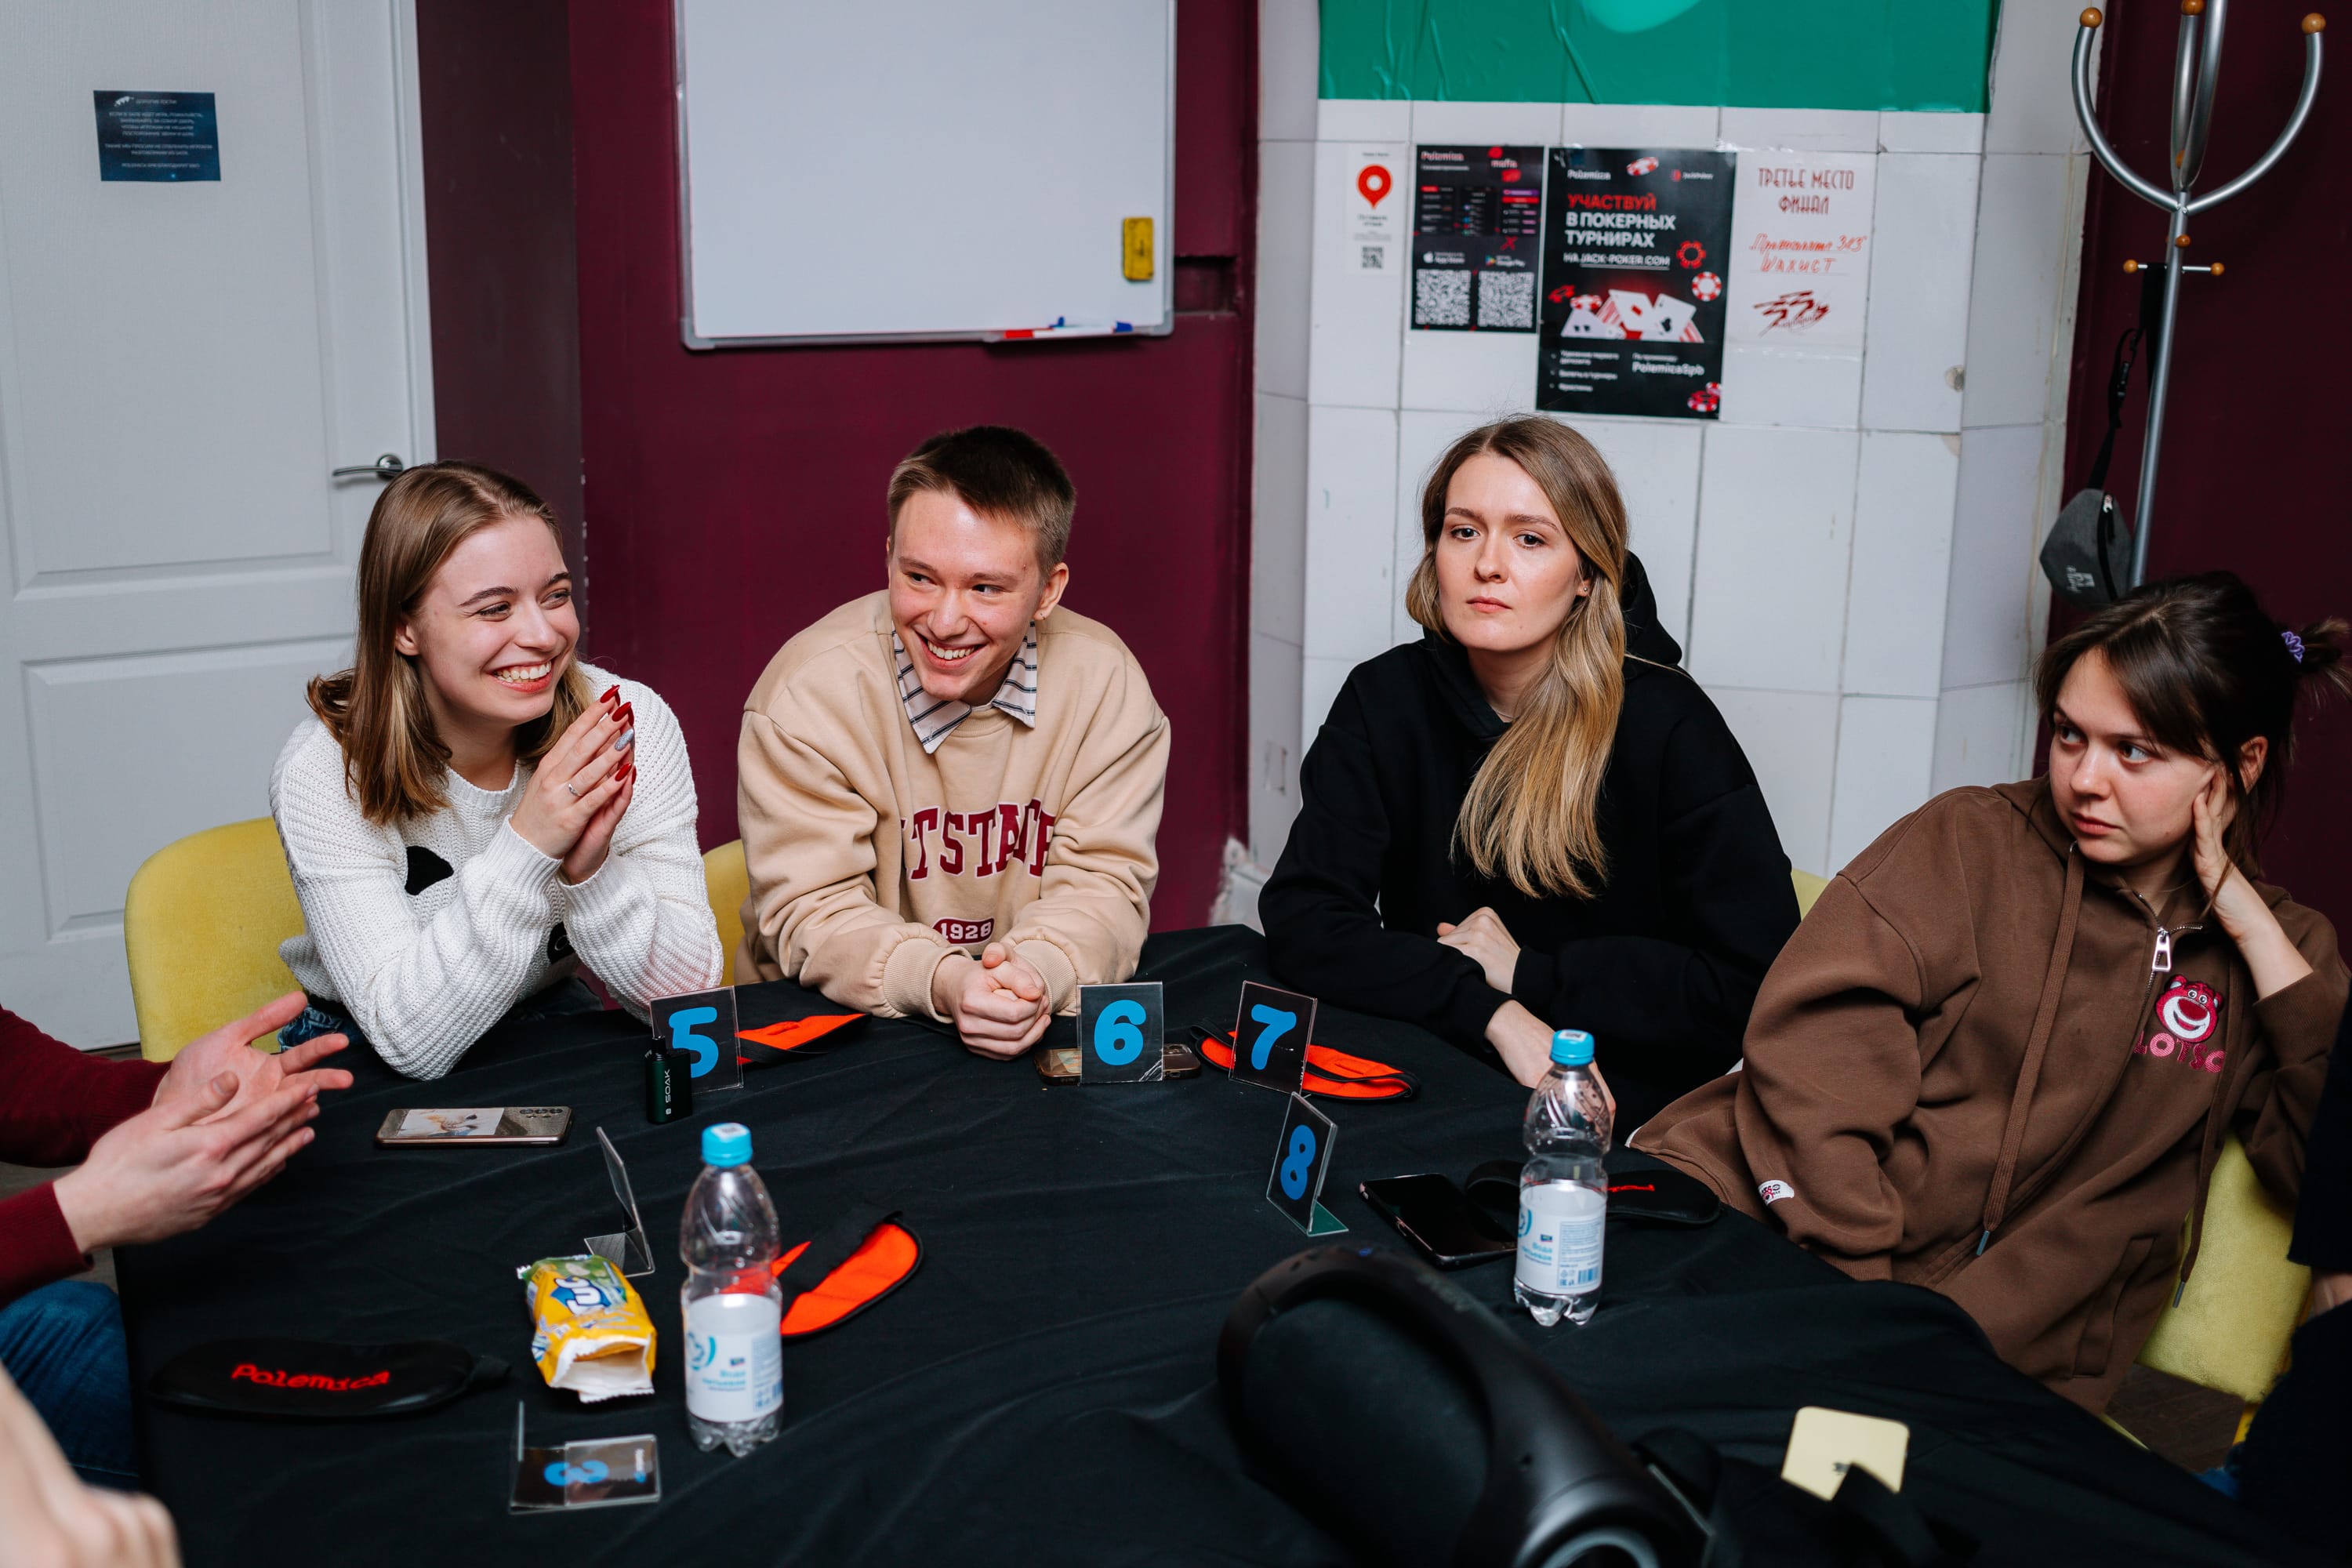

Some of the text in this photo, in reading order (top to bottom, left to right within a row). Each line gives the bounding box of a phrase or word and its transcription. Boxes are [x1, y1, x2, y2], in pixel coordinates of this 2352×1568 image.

[1759, 168, 1854, 190] ТРЕТЬЕ МЕСТО
[1568, 193, 1657, 211] УЧАСТВУЙ
[1778, 195, 1829, 214] ФИНАЛ
[1566, 212, 1676, 230] В ПОКЕРНЫХ
[1565, 230, 1655, 248] ТУРНИРАХ
[941, 921, 993, 940] 1928
[669, 1007, 719, 1078] 5
[1094, 1000, 1146, 1065] 6
[1250, 1004, 1297, 1070] 7
[1280, 1124, 1316, 1200] 8
[231, 1363, 390, 1392] Polemica
